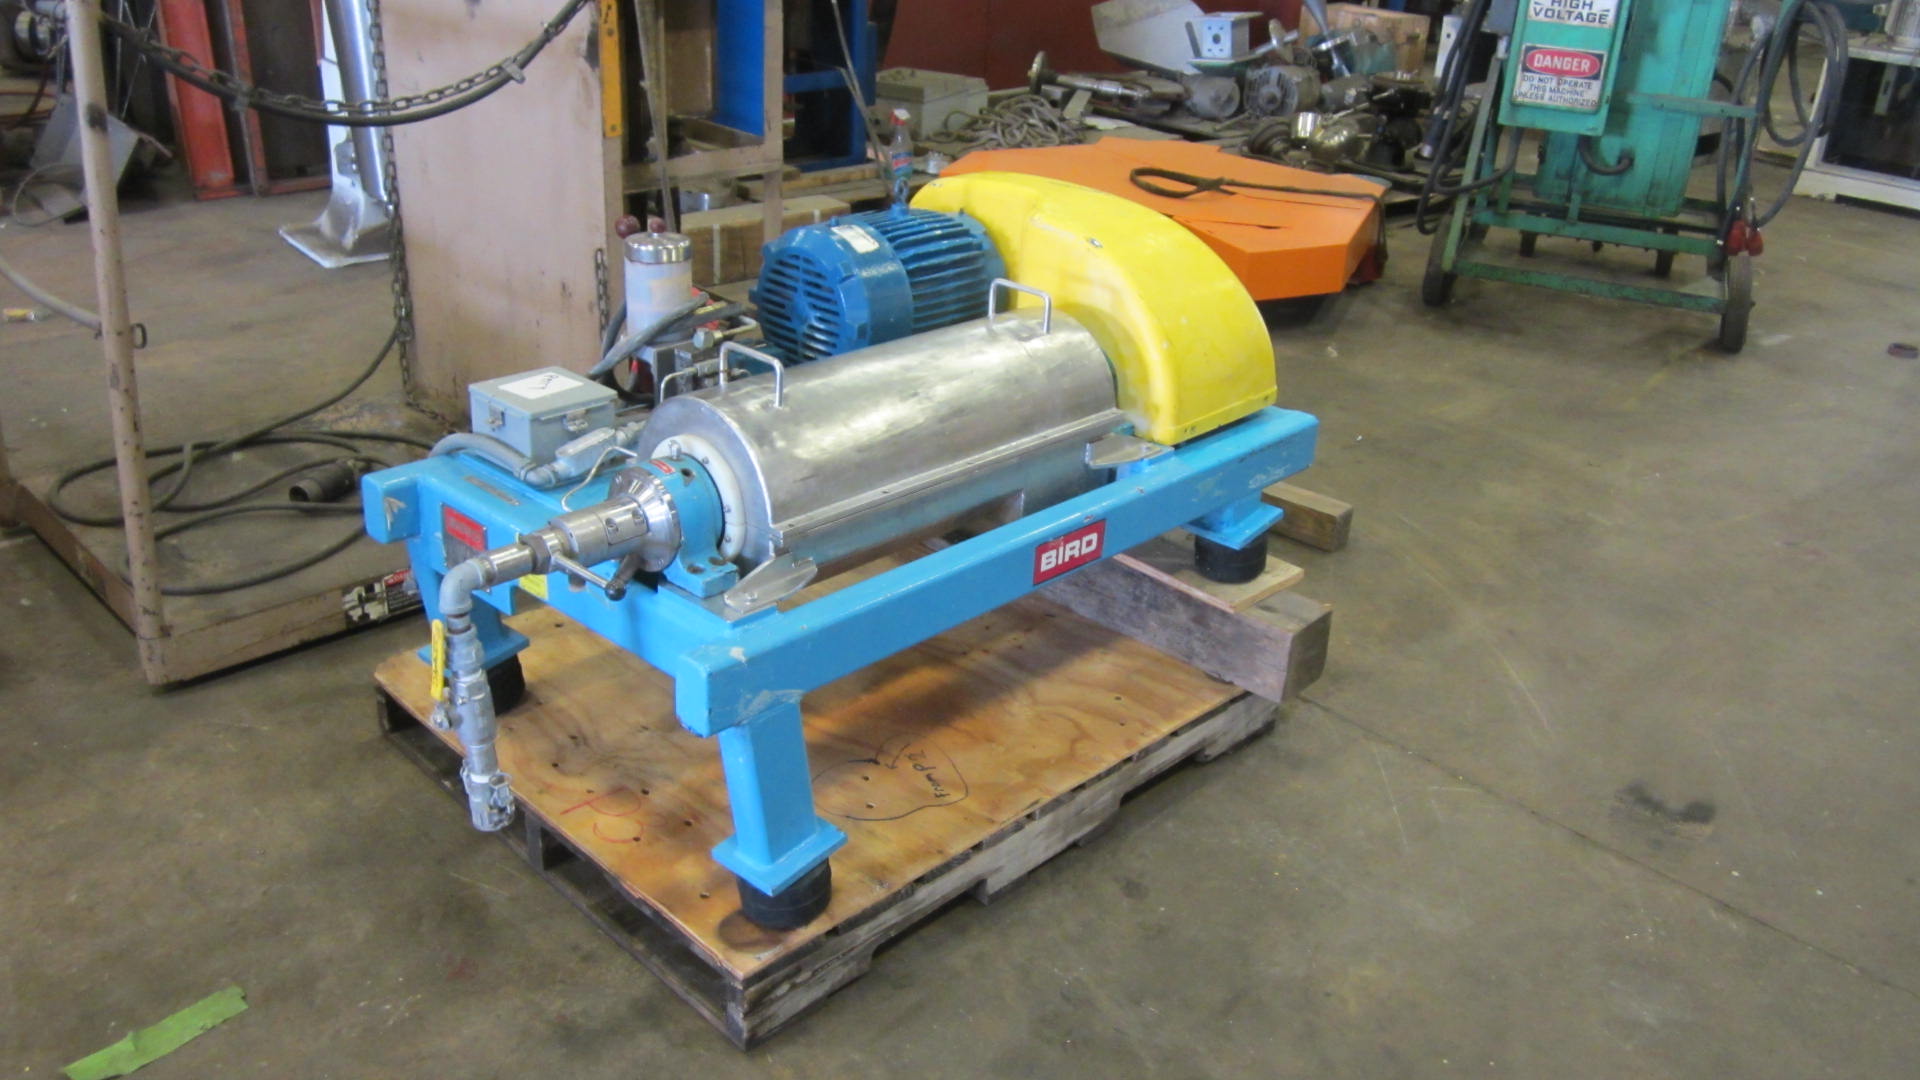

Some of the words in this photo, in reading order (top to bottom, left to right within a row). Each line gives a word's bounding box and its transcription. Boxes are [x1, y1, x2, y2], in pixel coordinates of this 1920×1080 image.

[1551, 0, 1593, 10] HIGH
[1533, 7, 1610, 24] VOLTAGE
[1534, 54, 1591, 72] DANGER
[1530, 84, 1546, 92] THIS
[1549, 86, 1585, 97] MACHINE
[1537, 76, 1553, 84] NOT
[1557, 79, 1593, 89] OPERATE
[1515, 90, 1545, 99] UNLESS
[1549, 95, 1597, 107] AUTHORIZED
[1041, 532, 1098, 572] BIRD
